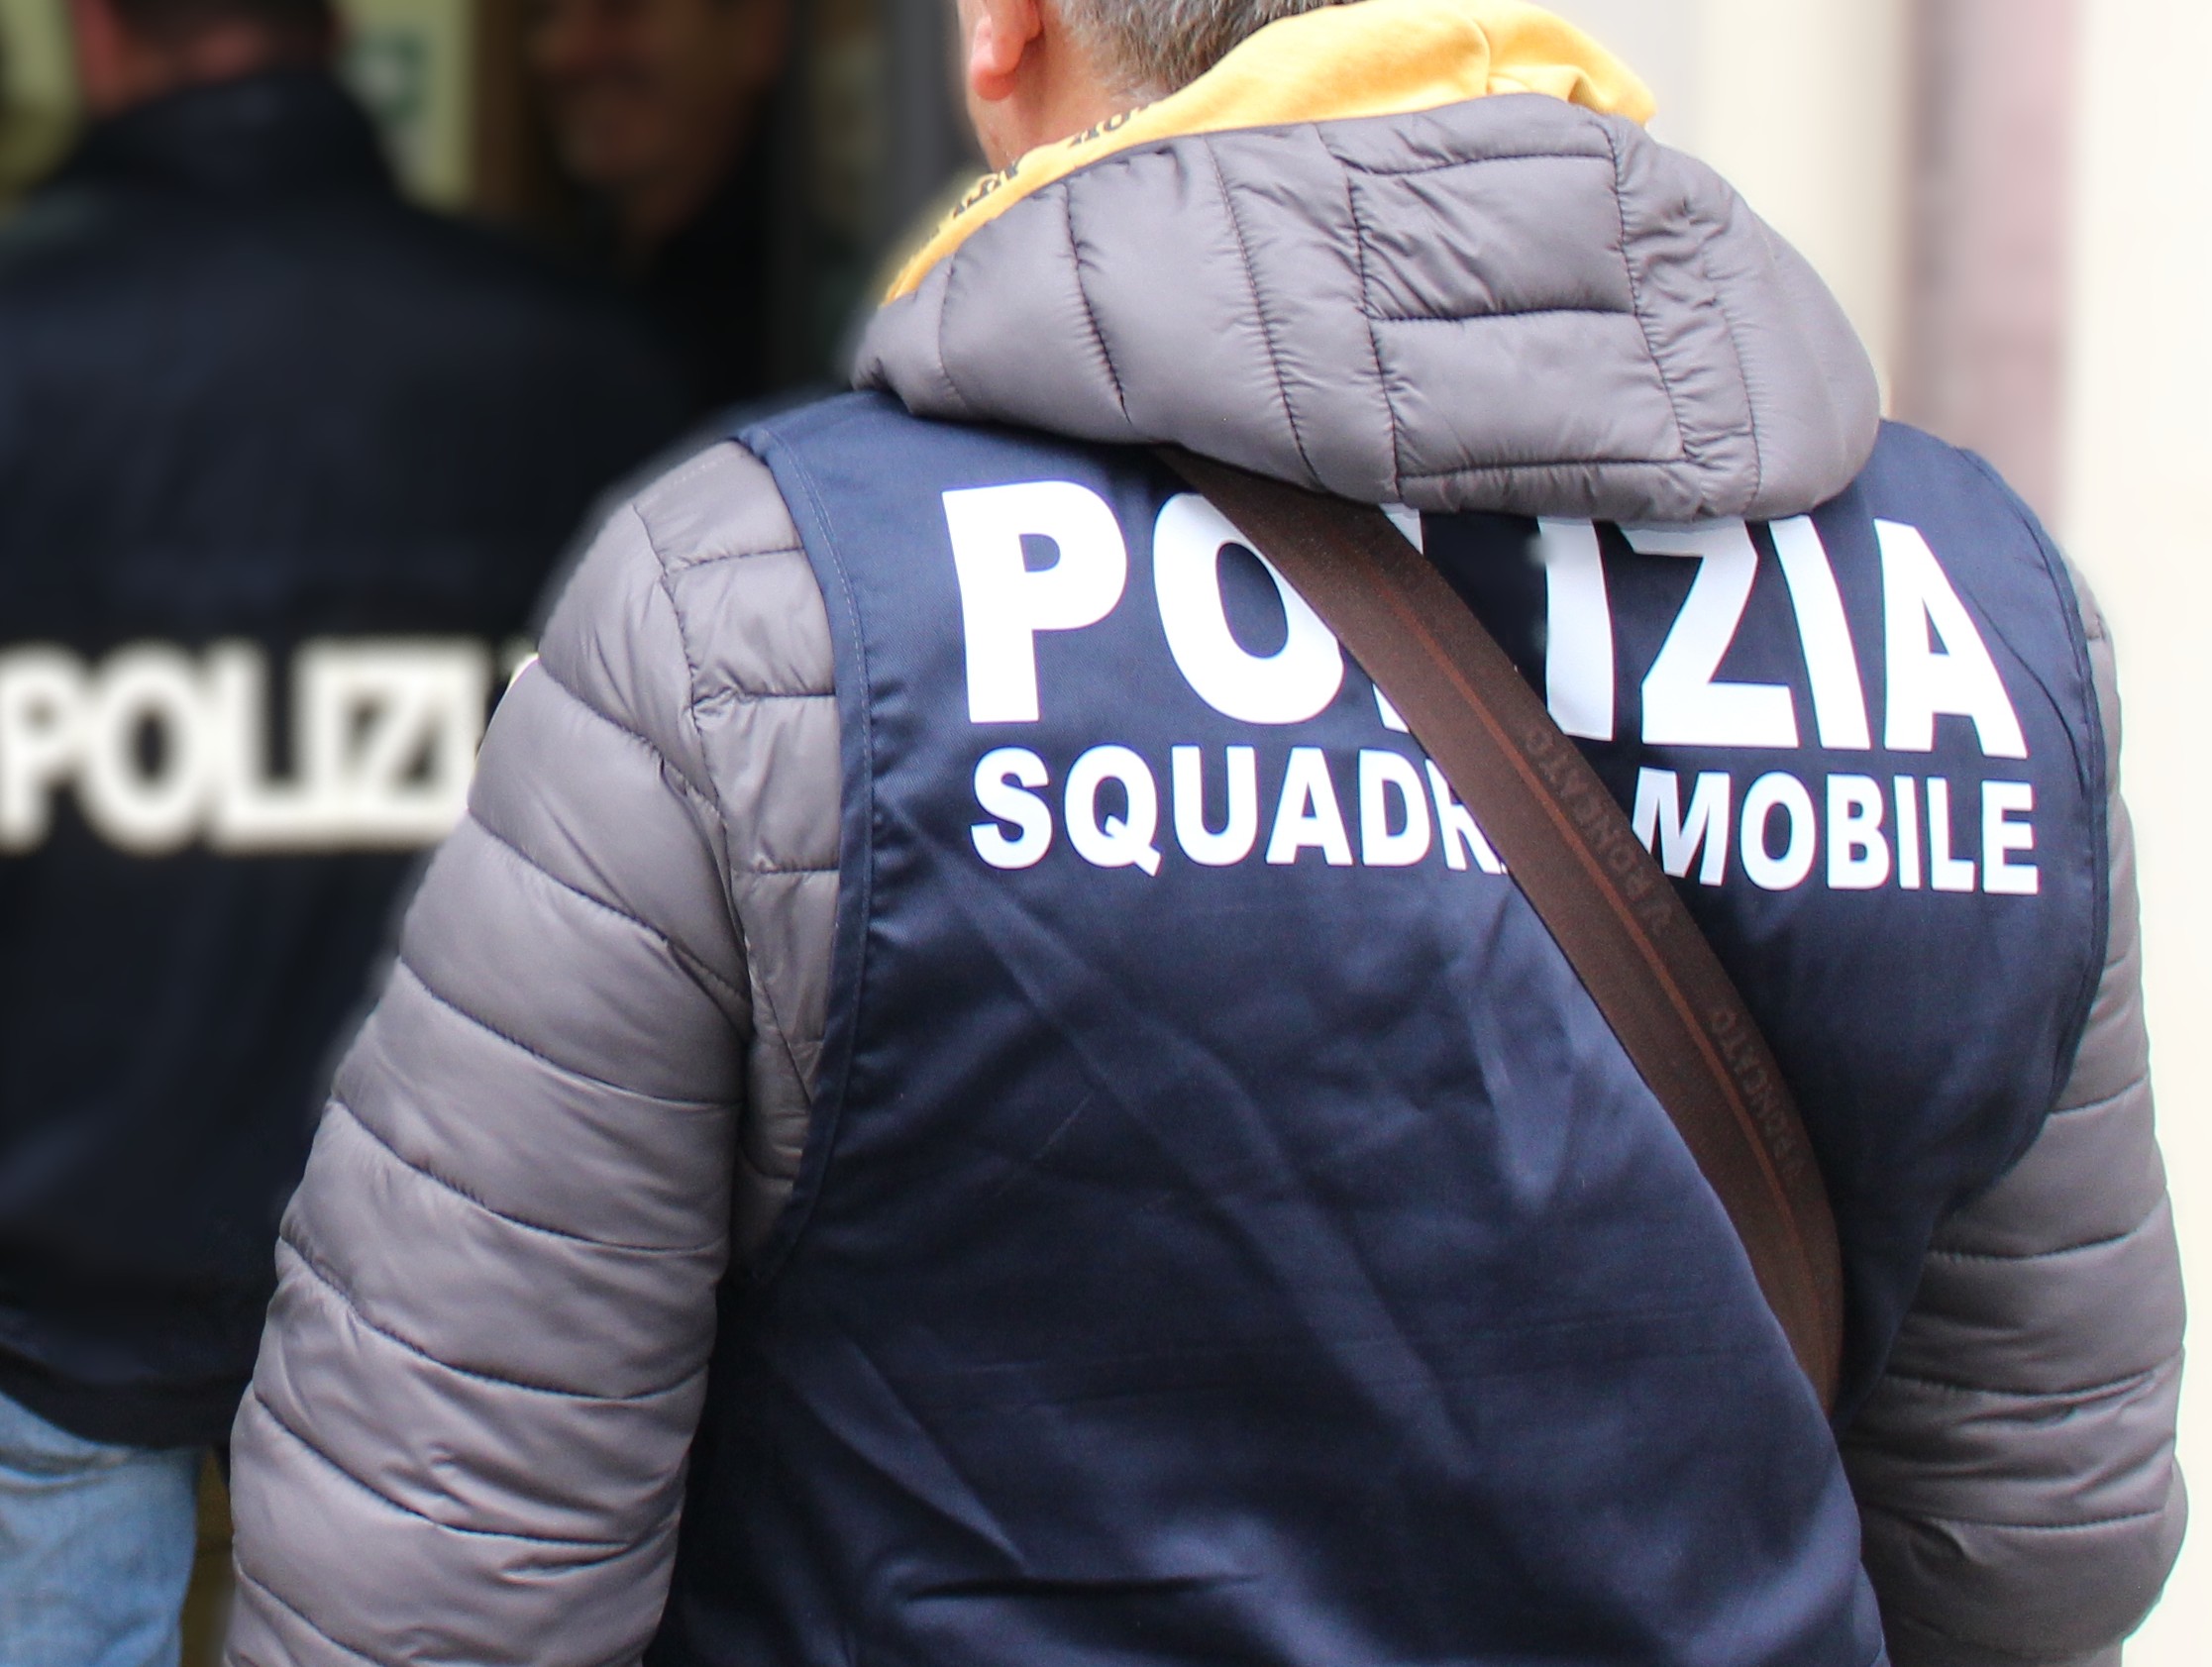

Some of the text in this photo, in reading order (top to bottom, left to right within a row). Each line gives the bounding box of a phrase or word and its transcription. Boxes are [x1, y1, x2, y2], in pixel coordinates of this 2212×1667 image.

[942, 480, 2028, 757] POIZIA
[0, 640, 538, 856] POLIZI
[970, 745, 2040, 895] SQUADR MOBILE
